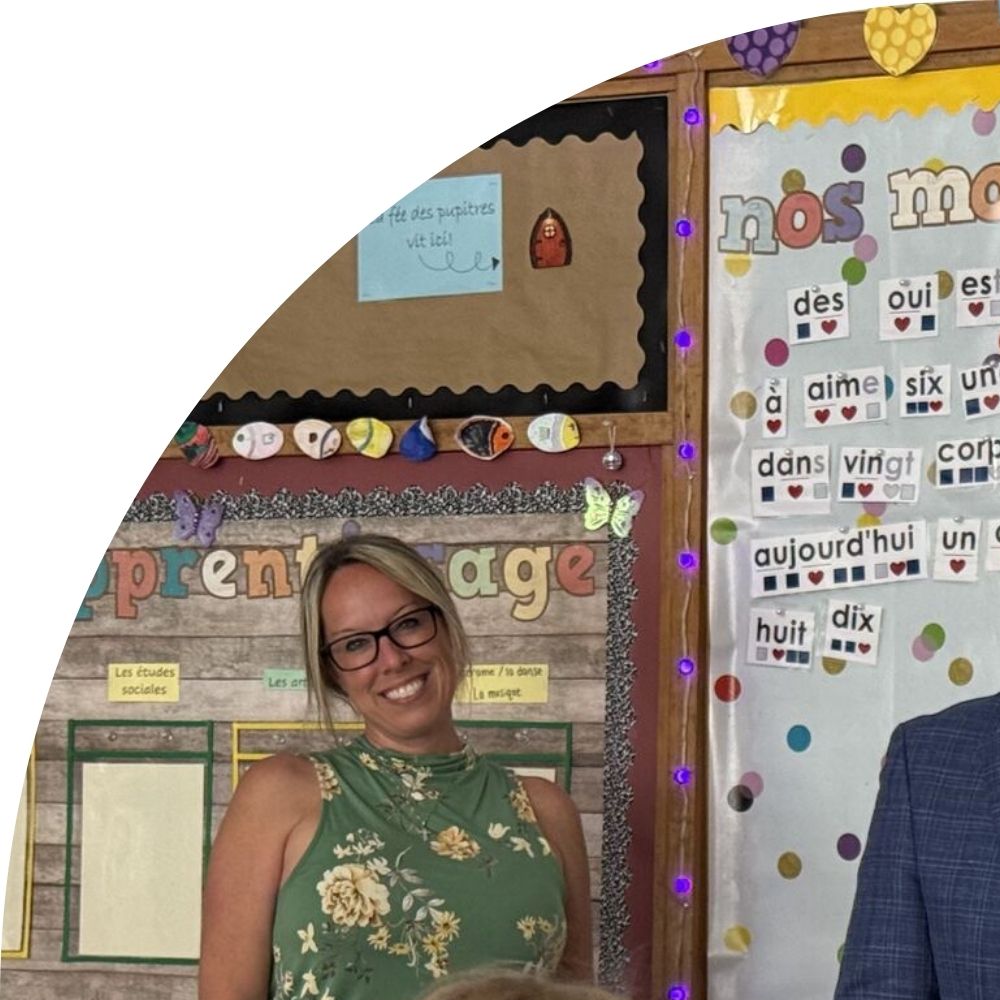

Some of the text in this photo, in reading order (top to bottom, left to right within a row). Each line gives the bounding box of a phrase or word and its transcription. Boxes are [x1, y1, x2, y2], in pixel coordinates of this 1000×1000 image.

[411, 205, 434, 220] des
[718, 181, 864, 254] nos
[794, 289, 844, 316] des
[888, 282, 931, 310] oui
[808, 374, 880, 401] aime
[906, 374, 943, 396] six
[758, 452, 825, 478] dans
[843, 449, 915, 481] vingt
[754, 525, 915, 569] aujourd'hui
[943, 530, 976, 550] un
[756, 618, 807, 645] huit
[832, 605, 874, 633] dix
[115, 665, 176, 678] Les études
[268, 677, 288, 688] Les
[122, 683, 167, 696] sociales
